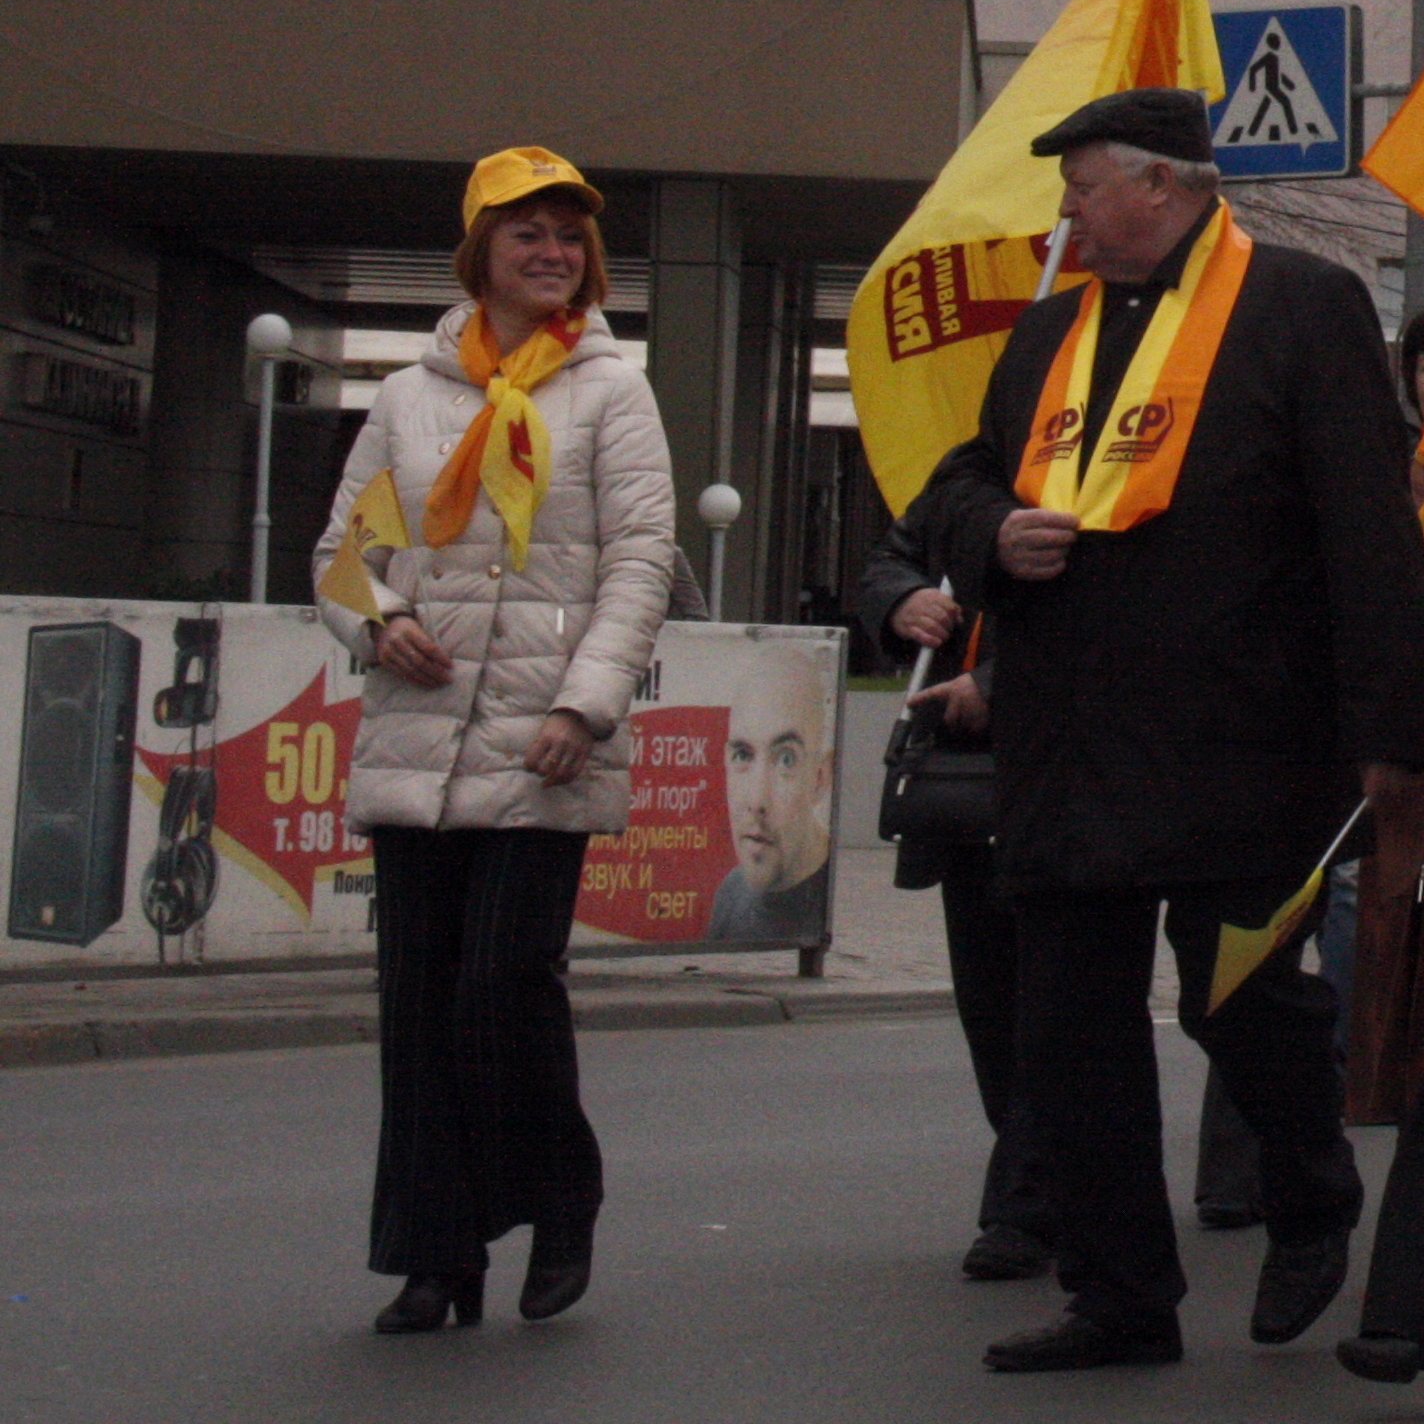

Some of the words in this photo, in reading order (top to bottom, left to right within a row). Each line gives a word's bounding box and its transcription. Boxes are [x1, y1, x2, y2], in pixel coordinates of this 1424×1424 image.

[1044, 408, 1079, 441] СР
[1118, 405, 1166, 437] СР
[651, 736, 708, 767] этаж
[300, 811, 334, 853] 98
[588, 825, 708, 858] инструменты
[582, 863, 632, 899] звук
[638, 864, 653, 890] и
[646, 891, 698, 920] свет
